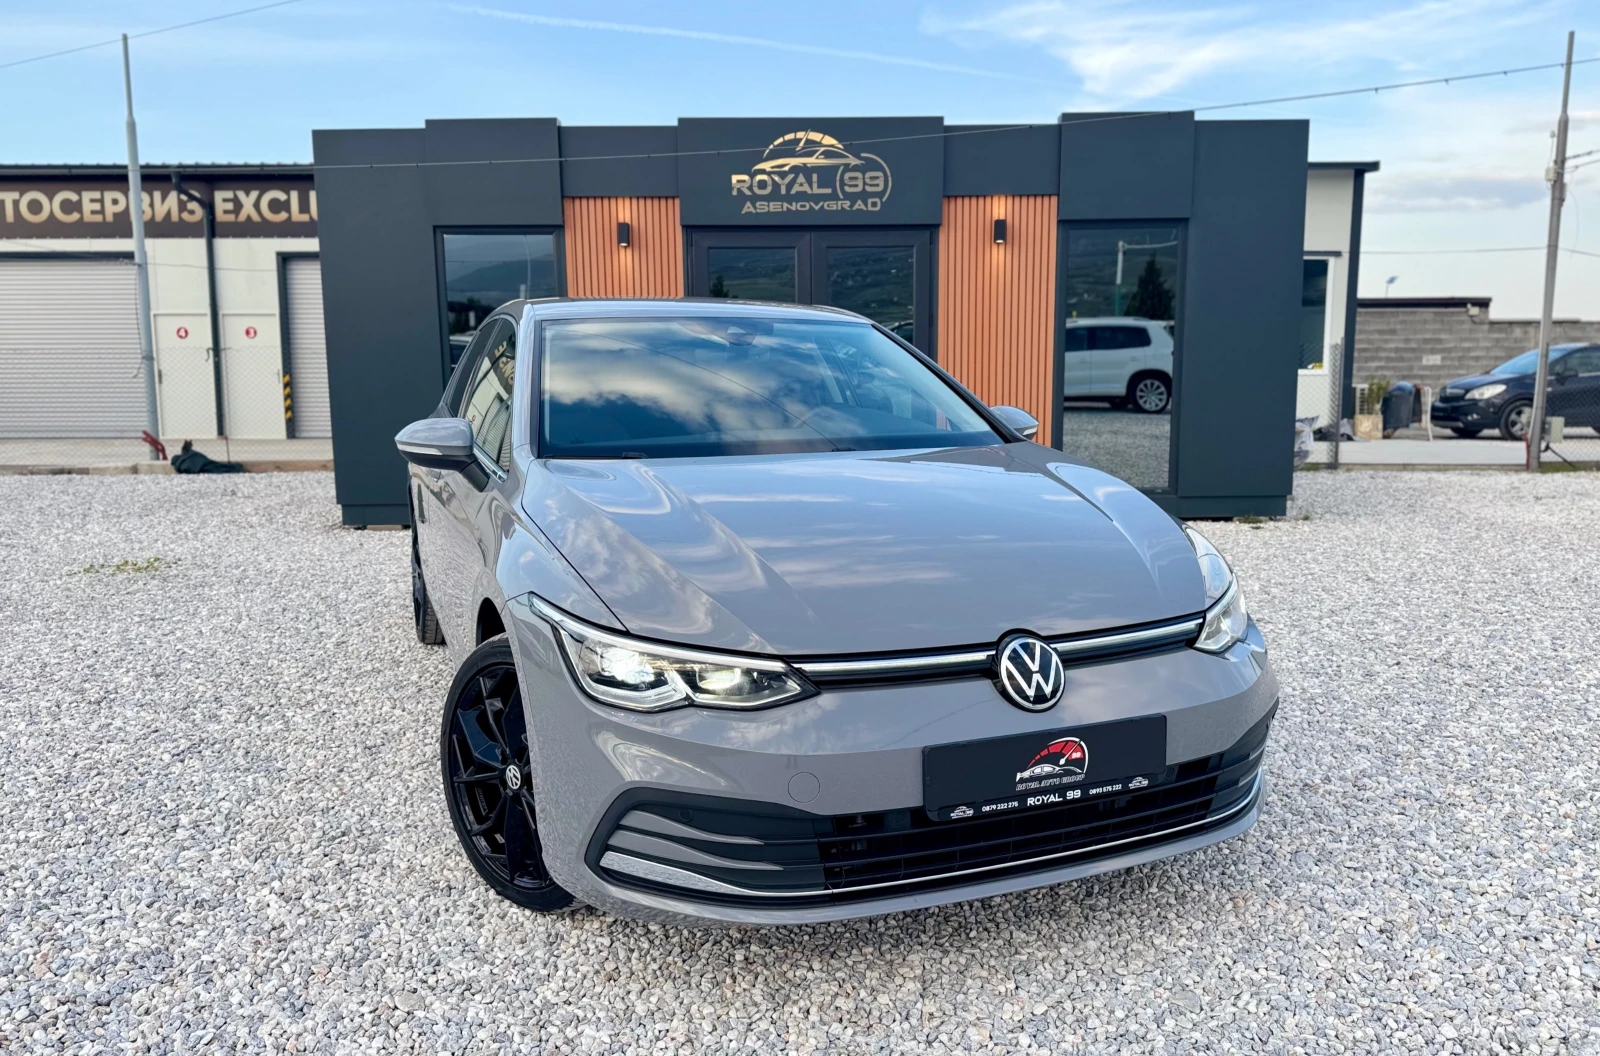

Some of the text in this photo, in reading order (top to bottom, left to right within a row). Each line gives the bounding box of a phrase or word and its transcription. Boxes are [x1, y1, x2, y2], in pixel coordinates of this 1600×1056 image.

[731, 173, 832, 196] ROYAL
[741, 198, 881, 215] ASENOVGRAD
[982, 804, 997, 812] 0879
[997, 802, 1007, 810] 222
[1008, 801, 1019, 809] 275
[1027, 793, 1063, 806] ROYAL
[1066, 789, 1081, 800] 99
